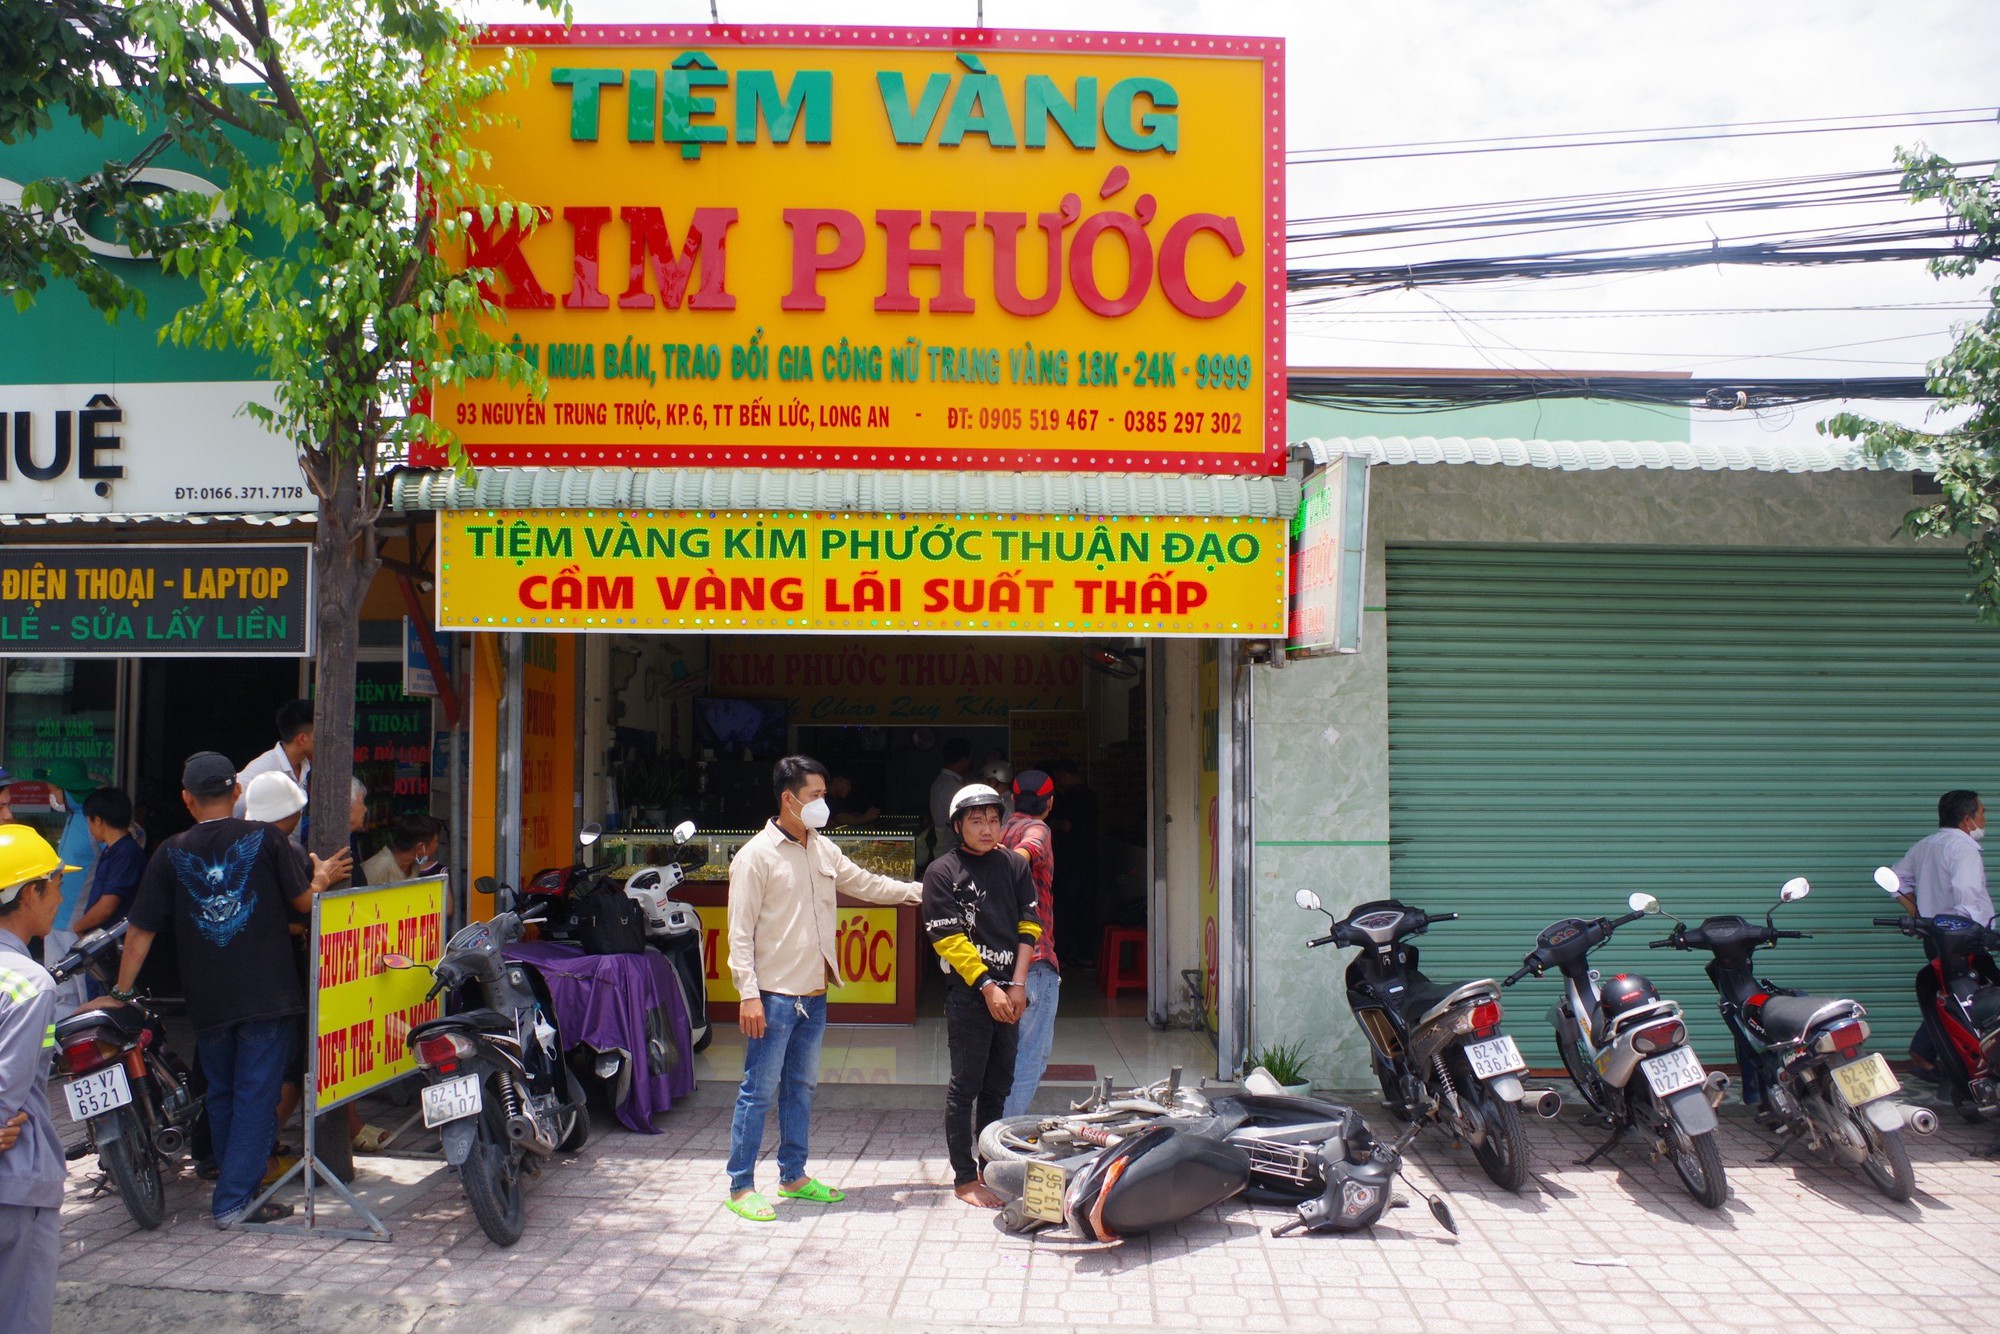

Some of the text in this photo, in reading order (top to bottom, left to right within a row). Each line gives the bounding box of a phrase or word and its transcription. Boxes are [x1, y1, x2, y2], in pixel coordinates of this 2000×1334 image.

[550, 51, 1180, 159] TIỆM VÀNG
[456, 166, 1248, 319] KIM PHƯỚC
[547, 342, 596, 379] MUA
[603, 335, 657, 386] BÁN,
[662, 343, 722, 380] TRAO
[730, 325, 769, 380] ĐỔI
[778, 344, 814, 381] GIA
[821, 336, 883, 381] CÔNG
[891, 337, 923, 382] NỮ
[927, 346, 1001, 384] TRANG
[1009, 342, 1069, 385] VÀNG
[1196, 353, 1252, 389] 9999
[455, 402, 479, 426] 93
[481, 393, 547, 426] NGUYỄN
[554, 402, 608, 427] TRUNG
[612, 399, 663, 431] TRỰC,
[712, 403, 734, 428] TT
[739, 396, 772, 429] BẾN
[777, 396, 817, 432] LỨC,
[819, 403, 862, 429] LONG
[867, 404, 891, 429] AN
[947, 406, 974, 430] ĐT:
[979, 407, 1023, 431] 0905
[1029, 408, 1062, 432] 519
[1065, 408, 1099, 432] 467
[1123, 409, 1169, 434] 0385
[1172, 411, 1206, 435] 297
[1210, 411, 1243, 436] 302
[0, 394, 126, 498] UỆ
[464, 519, 1263, 575] TIỆM VÀNG KIM PHƯỚC THUẬN ĐẠO
[1, 562, 67, 608] ĐIỆN
[75, 568, 155, 608] THOẠI
[183, 567, 289, 600] LAPTOP
[516, 564, 1209, 616] CẦM VÀNG LÃI SUẤT THẤP
[1, 606, 40, 640] LẺ
[71, 606, 135, 640] SỬA
[147, 606, 205, 640] LẤY
[217, 606, 287, 640] LIỀN
[716, 644, 1079, 693] KIM PHƯỚC THUẬN ĐẠO
[810, 696, 877, 720] Chào
[318, 901, 360, 991] CHUYỂN
[363, 903, 389, 978] TIỀN
[398, 905, 418, 959] RÚT
[420, 894, 441, 964] TIỀN
[316, 1028, 347, 1099] QUẸT
[350, 996, 374, 1077] THẺ
[1473, 1039, 1509, 1059] 62-N1
[1648, 1050, 1689, 1075] 59-P1
[73, 1069, 114, 1098] 53-V7
[430, 1080, 469, 1104] 62-L1
[1654, 1065, 1702, 1093] 027.99
[78, 1087, 120, 1116] 6521
[1044, 1173, 1062, 1212] 95-E1
